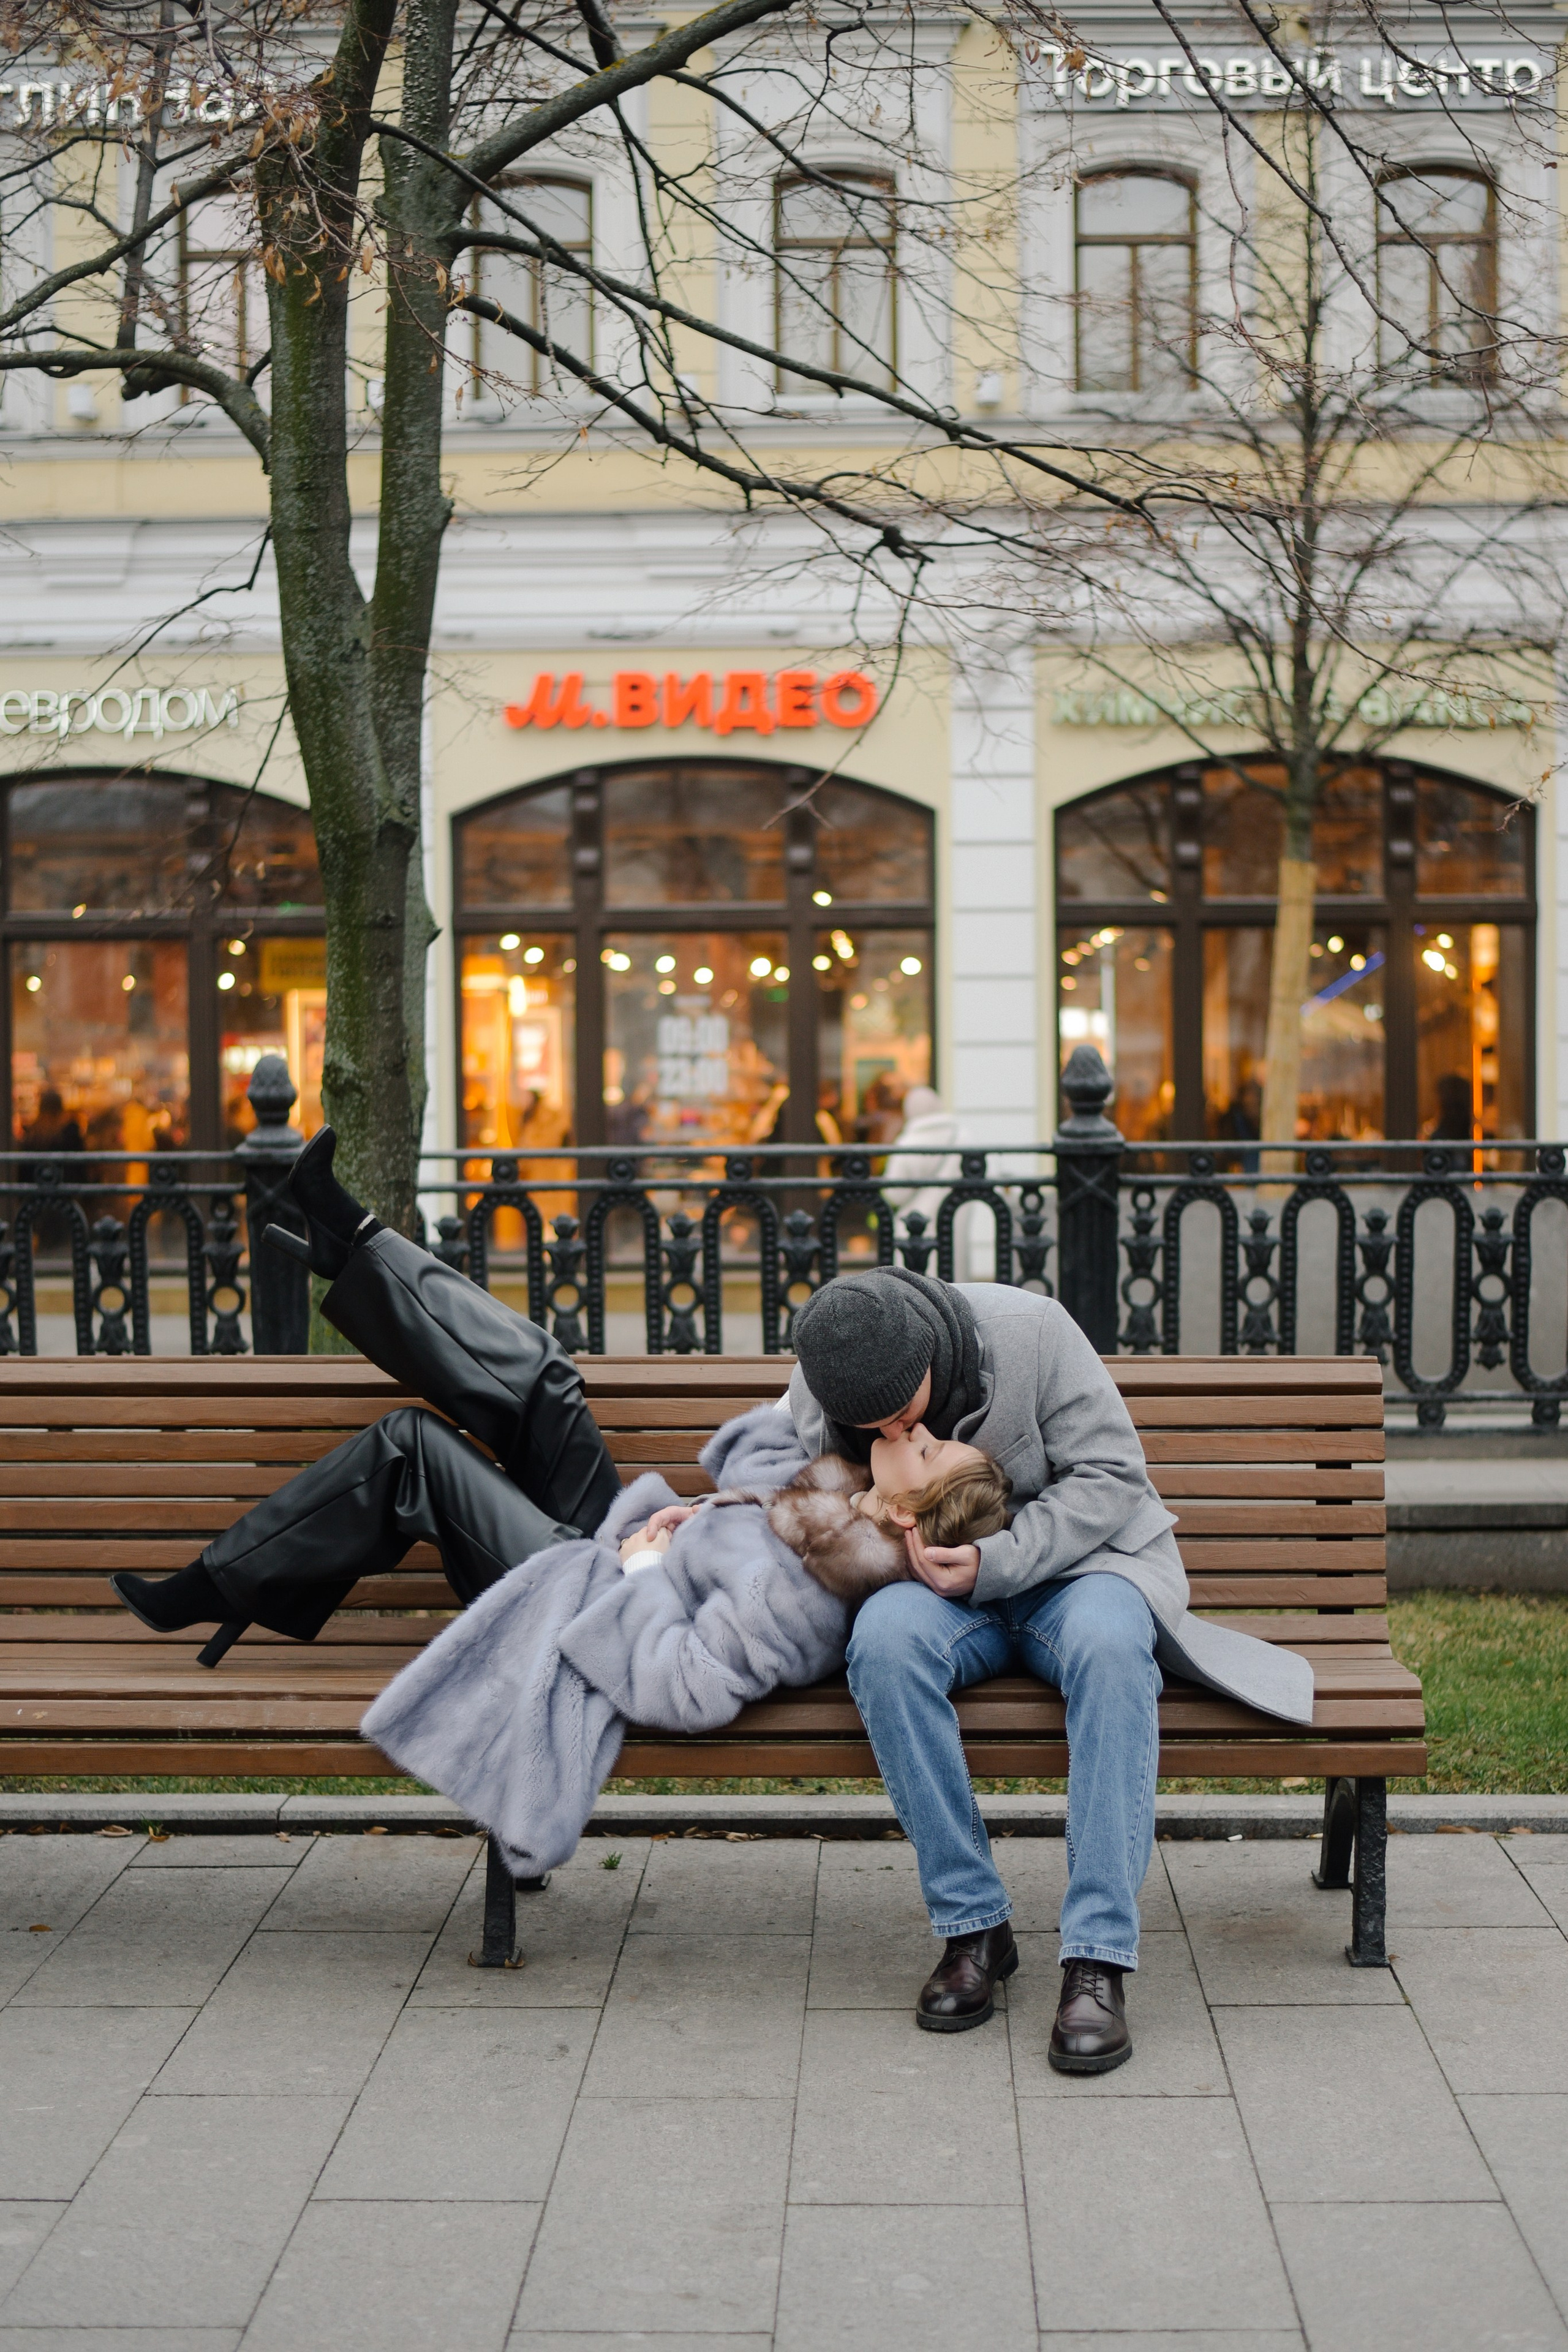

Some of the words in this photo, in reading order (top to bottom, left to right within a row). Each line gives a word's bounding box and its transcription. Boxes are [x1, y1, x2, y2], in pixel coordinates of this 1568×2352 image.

[1040, 43, 1343, 109] Торговый
[1359, 56, 1543, 108] центр
[0, 687, 239, 742] евродом
